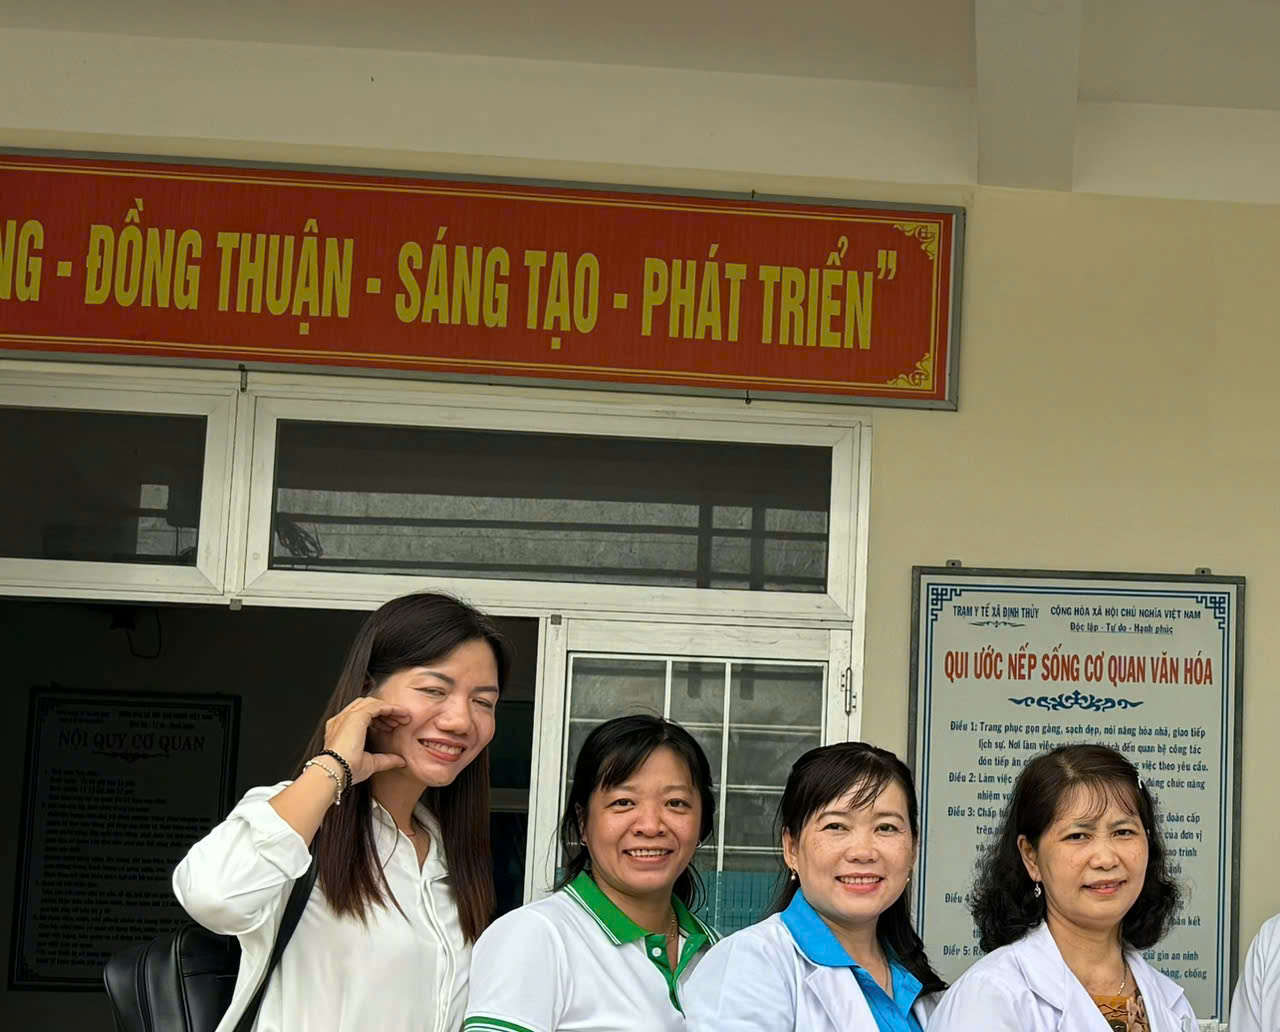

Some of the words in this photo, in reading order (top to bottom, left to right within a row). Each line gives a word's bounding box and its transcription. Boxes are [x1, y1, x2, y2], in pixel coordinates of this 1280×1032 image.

[84, 196, 202, 312] ĐỒNG
[216, 218, 353, 336] THUẬN
[395, 225, 510, 329] SÁNG
[524, 248, 599, 352] TẠO
[641, 243, 748, 343] PHÁT
[953, 605, 973, 620] TRẠM
[974, 606, 979, 617] Y
[981, 602, 990, 616] TẾ
[1050, 606, 1072, 619] CỘNG
[1074, 604, 1090, 617] HÒA
[1092, 604, 1103, 617] XÃ
[1105, 606, 1118, 619] HỘI
[1120, 604, 1137, 617] CHỦ
[1138, 606, 1162, 618] NGHĨA
[1164, 608, 1181, 620] VIỆT
[1184, 609, 1201, 620] NAM
[1070, 621, 1084, 633] Độc
[1134, 623, 1153, 635] Hạnh
[944, 650, 969, 683] QUI
[974, 644, 1003, 680] ƯỚC
[1008, 642, 1037, 681] NẾP
[1041, 643, 1080, 682] SỐNG
[1084, 651, 1105, 683] CƠ
[1108, 654, 1146, 687] QUAN
[1150, 651, 1179, 684] VĂN
[1184, 650, 1213, 685] HÓA
[950, 720, 968, 732] Điều
[971, 722, 978, 732] 1:
[980, 722, 1002, 734] Trang
[1004, 723, 1023, 734] phục
[1026, 725, 1040, 735] gọn
[1066, 724, 1083, 735] sạch
[1104, 726, 1116, 735] nói
[1118, 726, 1136, 737] năng
[1172, 727, 1189, 738] giao
[1191, 726, 1206, 738] tiếp
[978, 739, 992, 751] lịch
[1023, 740, 1037, 750] làm
[1138, 744, 1155, 754] quan
[1169, 745, 1187, 756] công
[1190, 744, 1202, 755] tác
[978, 756, 992, 766] đón
[994, 756, 1009, 768] tiếp
[1142, 761, 1156, 771] việc
[1158, 761, 1175, 771] theo
[1178, 761, 1191, 772] yêu
[949, 772, 966, 783] Điều
[968, 773, 976, 783] 2:
[978, 774, 995, 784] Làm
[997, 774, 1012, 784] việc
[1186, 780, 1206, 790] năng
[978, 792, 1000, 802] nhiệm
[948, 806, 965, 817] Điều
[968, 808, 975, 817] 3:
[978, 807, 997, 819] Chấp
[1186, 812, 1200, 824] cấp
[1165, 828, 1178, 840] của
[1179, 848, 1197, 857] trình
[945, 893, 962, 904] Điều
[964, 946, 971, 956] 5:
[1171, 952, 1180, 961] an
[1183, 950, 1199, 962] ninh
[1184, 968, 1208, 980] chống
